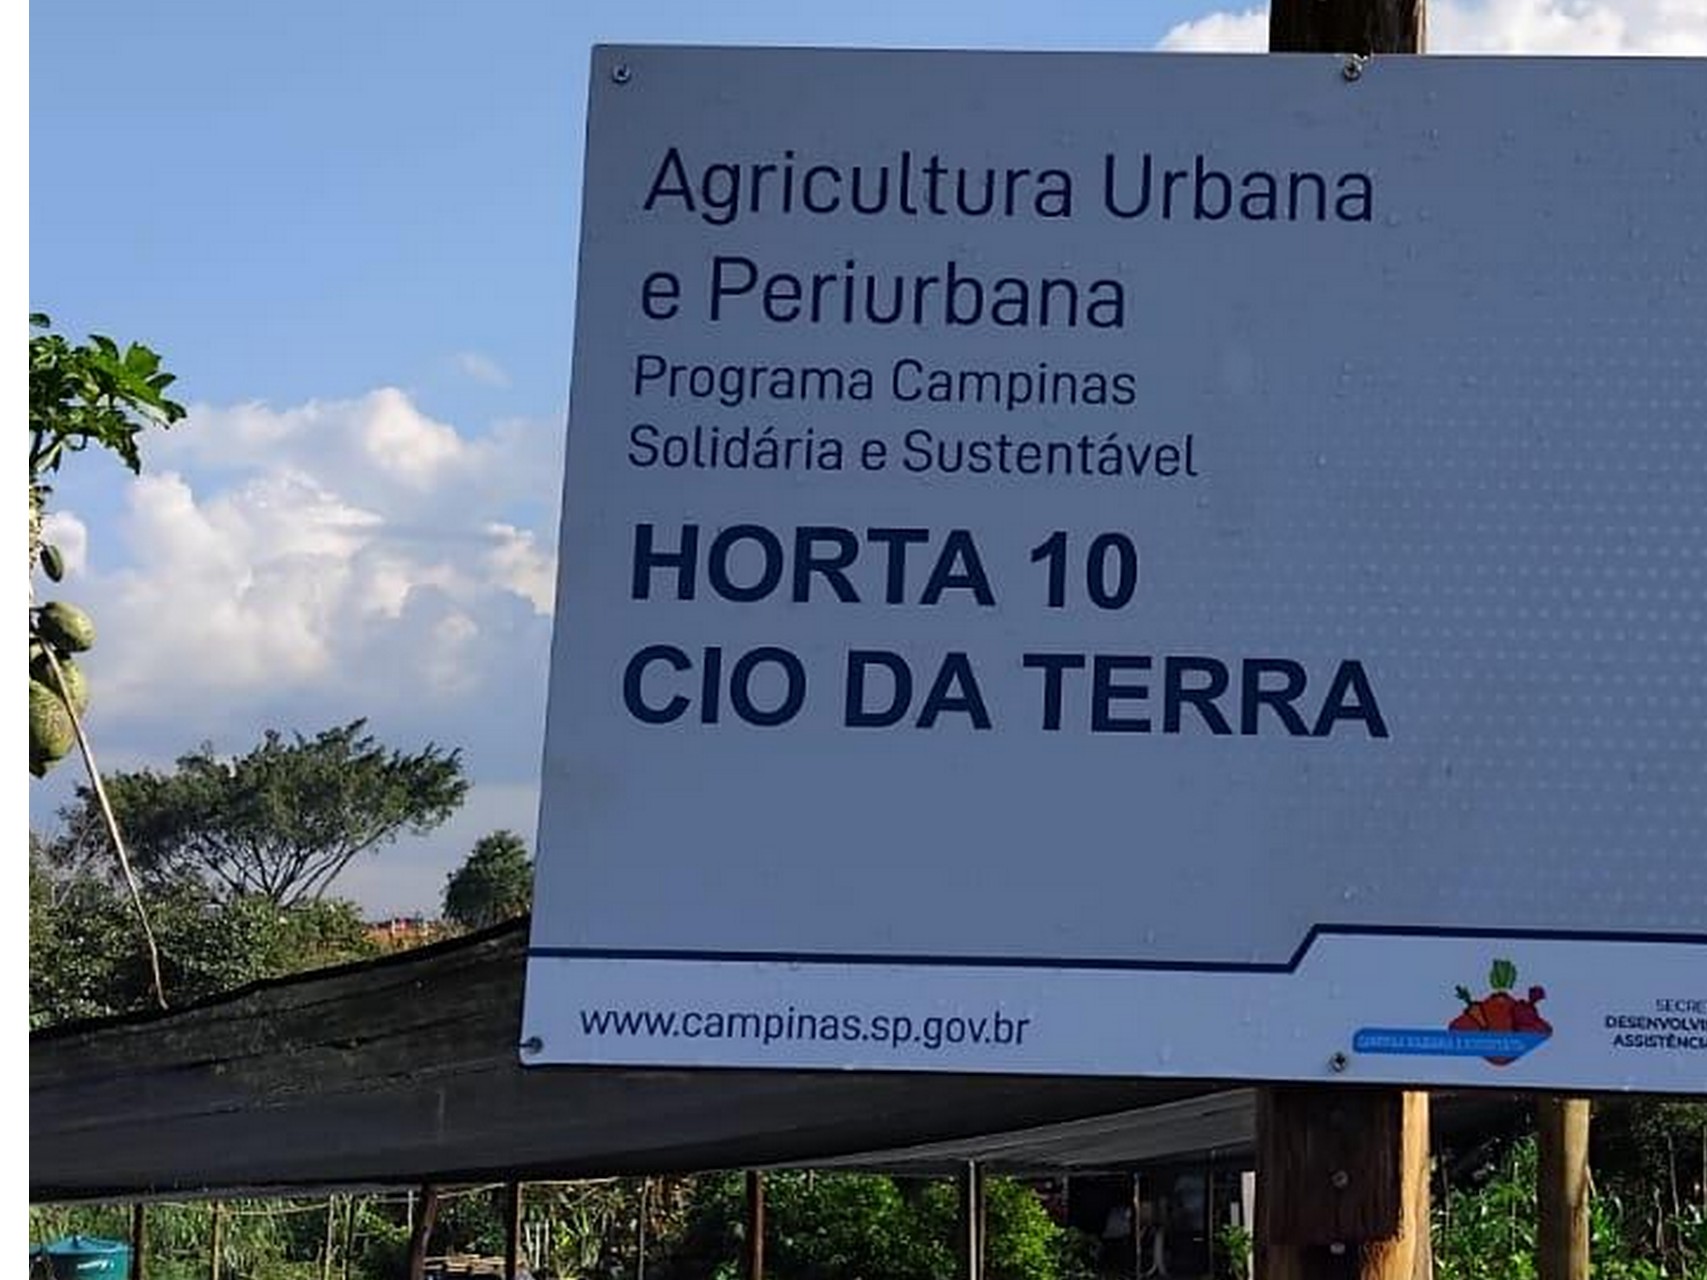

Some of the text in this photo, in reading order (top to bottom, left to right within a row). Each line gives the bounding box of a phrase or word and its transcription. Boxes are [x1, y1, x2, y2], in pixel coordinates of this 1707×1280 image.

[642, 146, 1373, 226] Agricultura Urbana
[641, 255, 1124, 329] e Periurbana
[634, 353, 1136, 412] Programa Campinas
[628, 423, 1198, 477] Solidária e Sustentável
[631, 523, 1138, 611] HORTA 10
[623, 644, 1389, 739] CIO DA TERRA
[580, 1006, 1031, 1050] www.campinas.sp.gov.br
